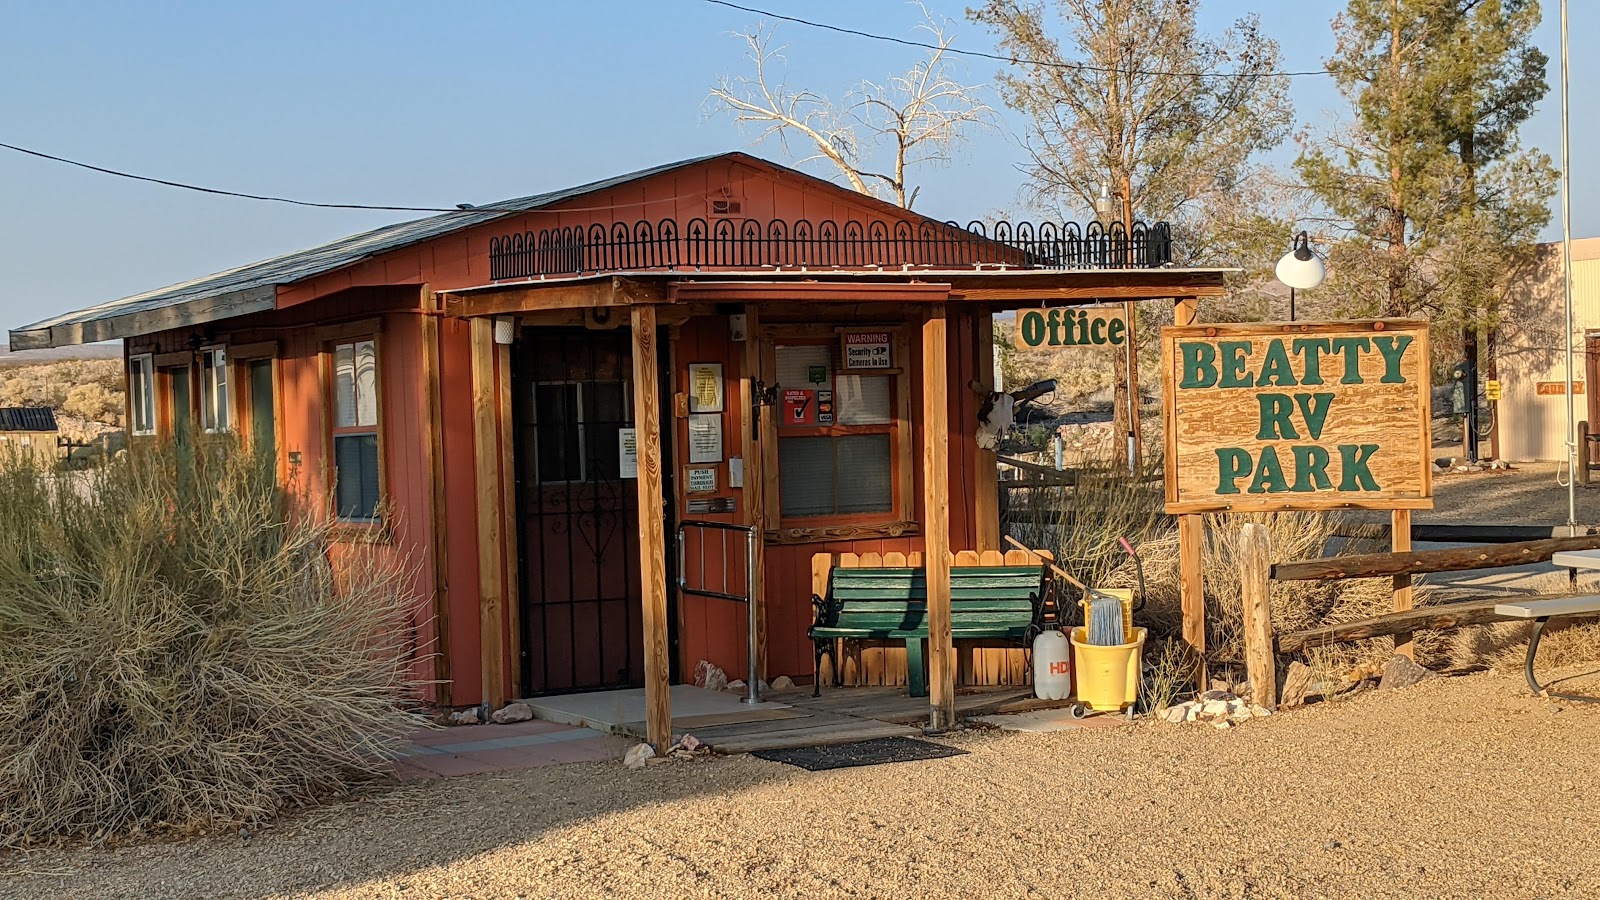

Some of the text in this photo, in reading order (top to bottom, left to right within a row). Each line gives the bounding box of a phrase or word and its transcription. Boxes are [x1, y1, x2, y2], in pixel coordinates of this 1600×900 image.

[846, 333, 888, 344] WARNING
[1021, 308, 1125, 347] Office
[848, 346, 871, 357] Security
[848, 357, 871, 367] Cameras
[1179, 336, 1414, 390] BEATTY
[1537, 382, 1584, 395] Launry
[1255, 392, 1336, 441] RV
[1214, 443, 1381, 495] PARK
